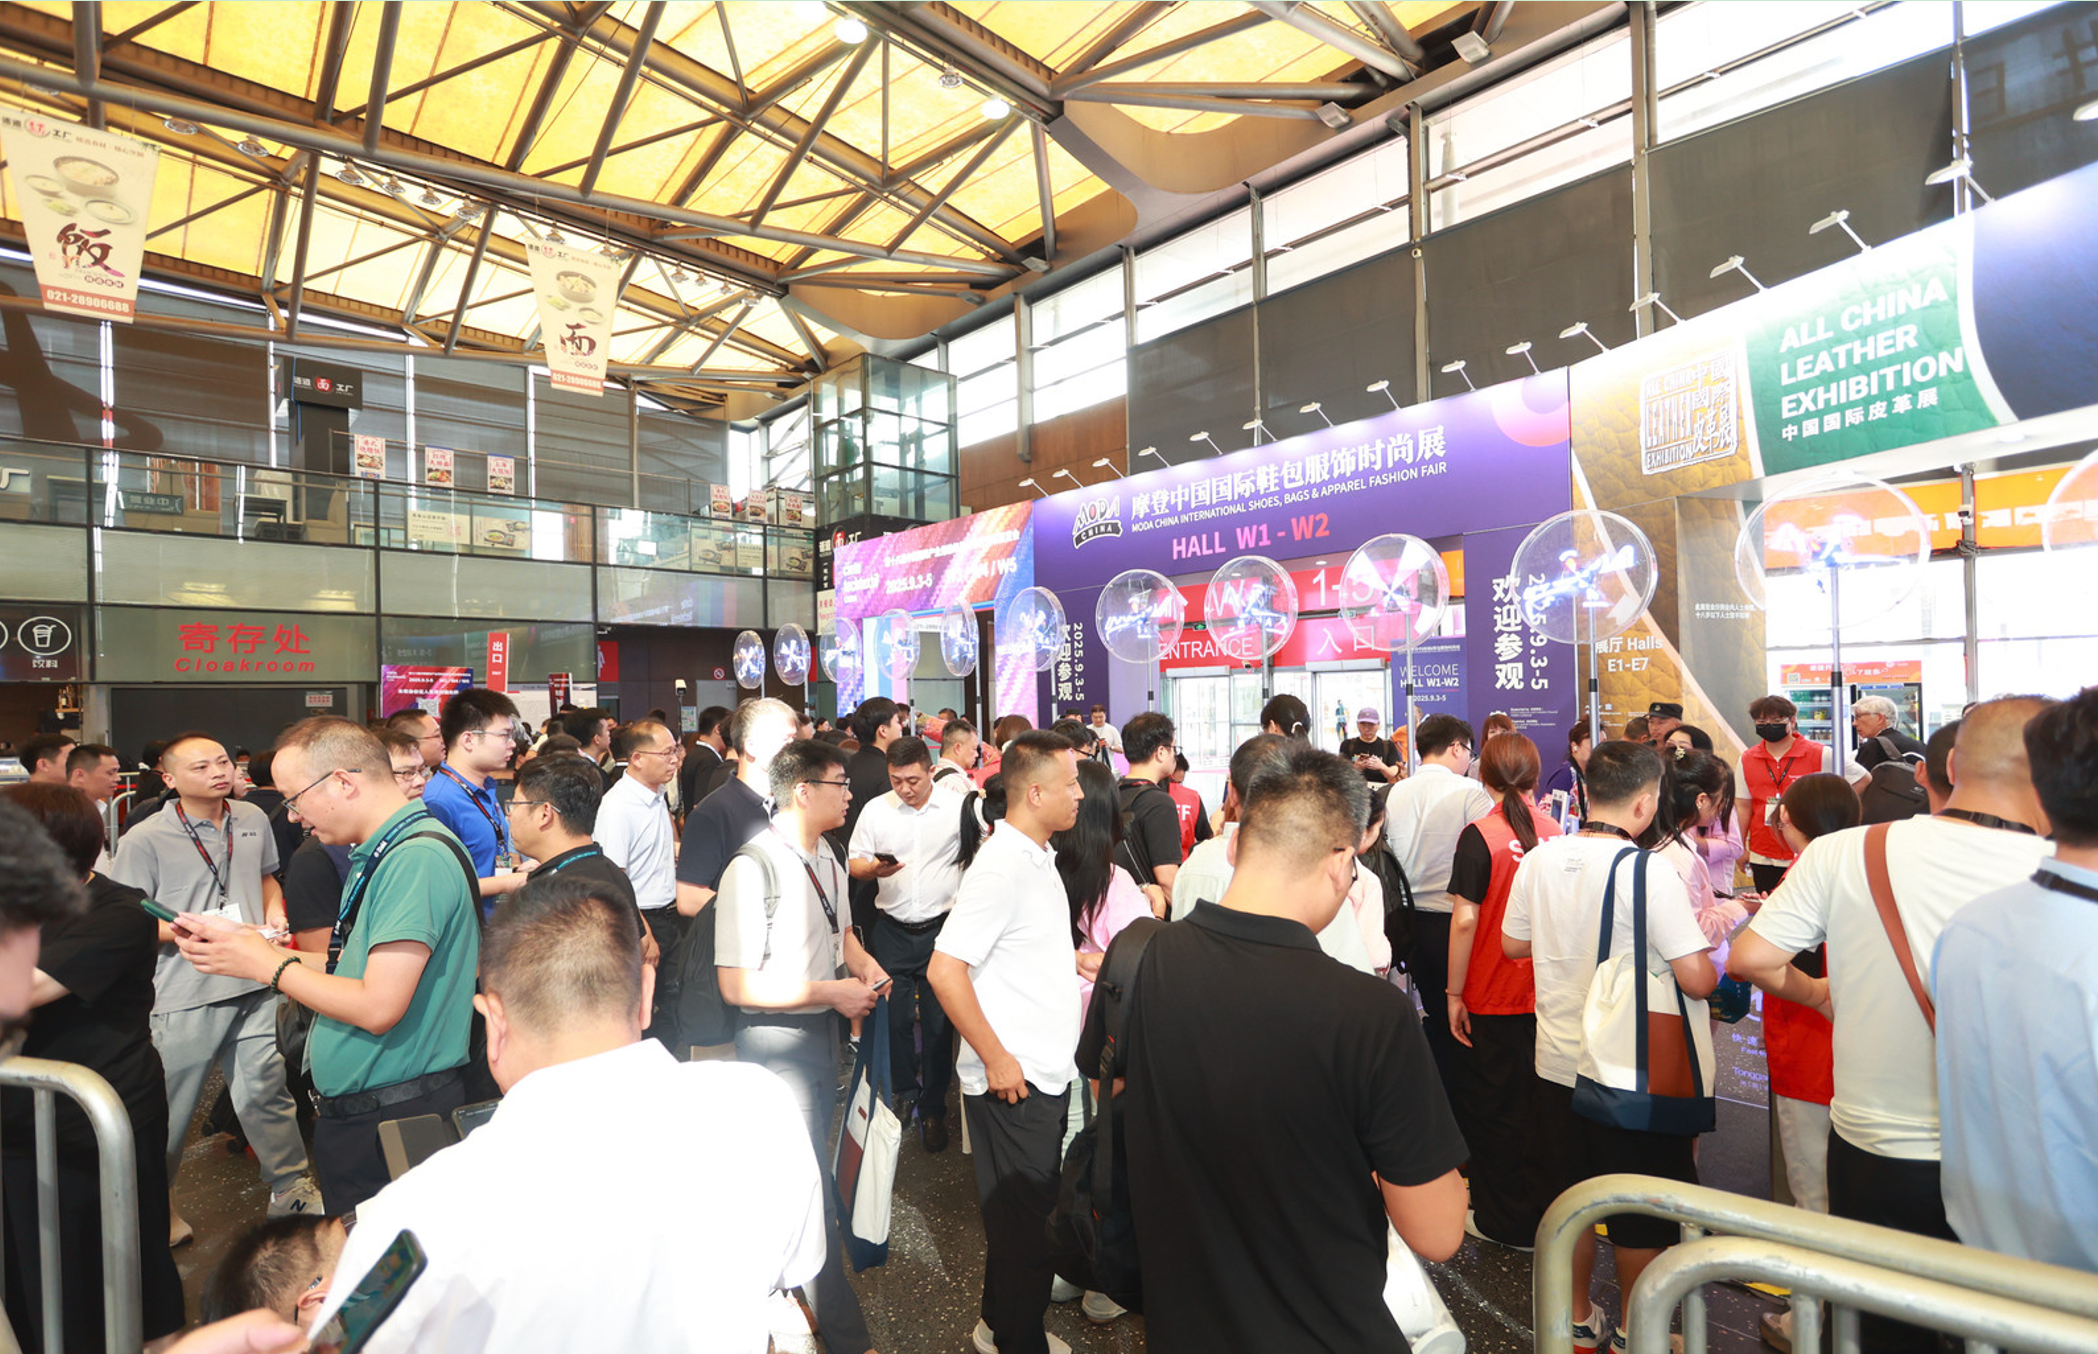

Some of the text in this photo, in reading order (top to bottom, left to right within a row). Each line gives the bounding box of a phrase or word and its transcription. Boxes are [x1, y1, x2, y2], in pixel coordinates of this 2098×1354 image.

[1780, 277, 1949, 353] ALL CHINA
[1780, 322, 1918, 386] LEATHER
[1781, 347, 1965, 420] EXHIBITION
[1781, 388, 1939, 442] 中国国际皮革展
[1131, 424, 1447, 521] 摩登中国国际鞋包服饰时尚展
[1646, 444, 1694, 470] EXHIBITION
[1131, 461, 1447, 533] MODA CHINA INTERNATIONAL SHOES, BAGS & APPAREL FASHION FAIR
[1080, 522, 1113, 542] CHINA
[1172, 531, 1227, 561] HALL
[1235, 523, 1272, 551] W1
[1290, 512, 1331, 541] W2
[886, 572, 933, 595] 2025.9.3-5
[997, 556, 1018, 575] W5
[178, 622, 311, 655] 寄存处
[1316, 624, 1376, 656] 入口
[1492, 574, 1525, 690] 欢迎参观
[1596, 635, 1664, 654] 展厅 Halls
[492, 640, 504, 664] 出口
[1073, 622, 1085, 702] 2025.9.3-5
[1158, 637, 1254, 660] ENTRANCE
[174, 657, 316, 673] Cloakroom
[1399, 662, 1460, 678] WELCOME
[1607, 657, 1650, 673] E1-E7
[1400, 676, 1460, 689] HLL W1-W2
[290, 1198, 307, 1212] N
